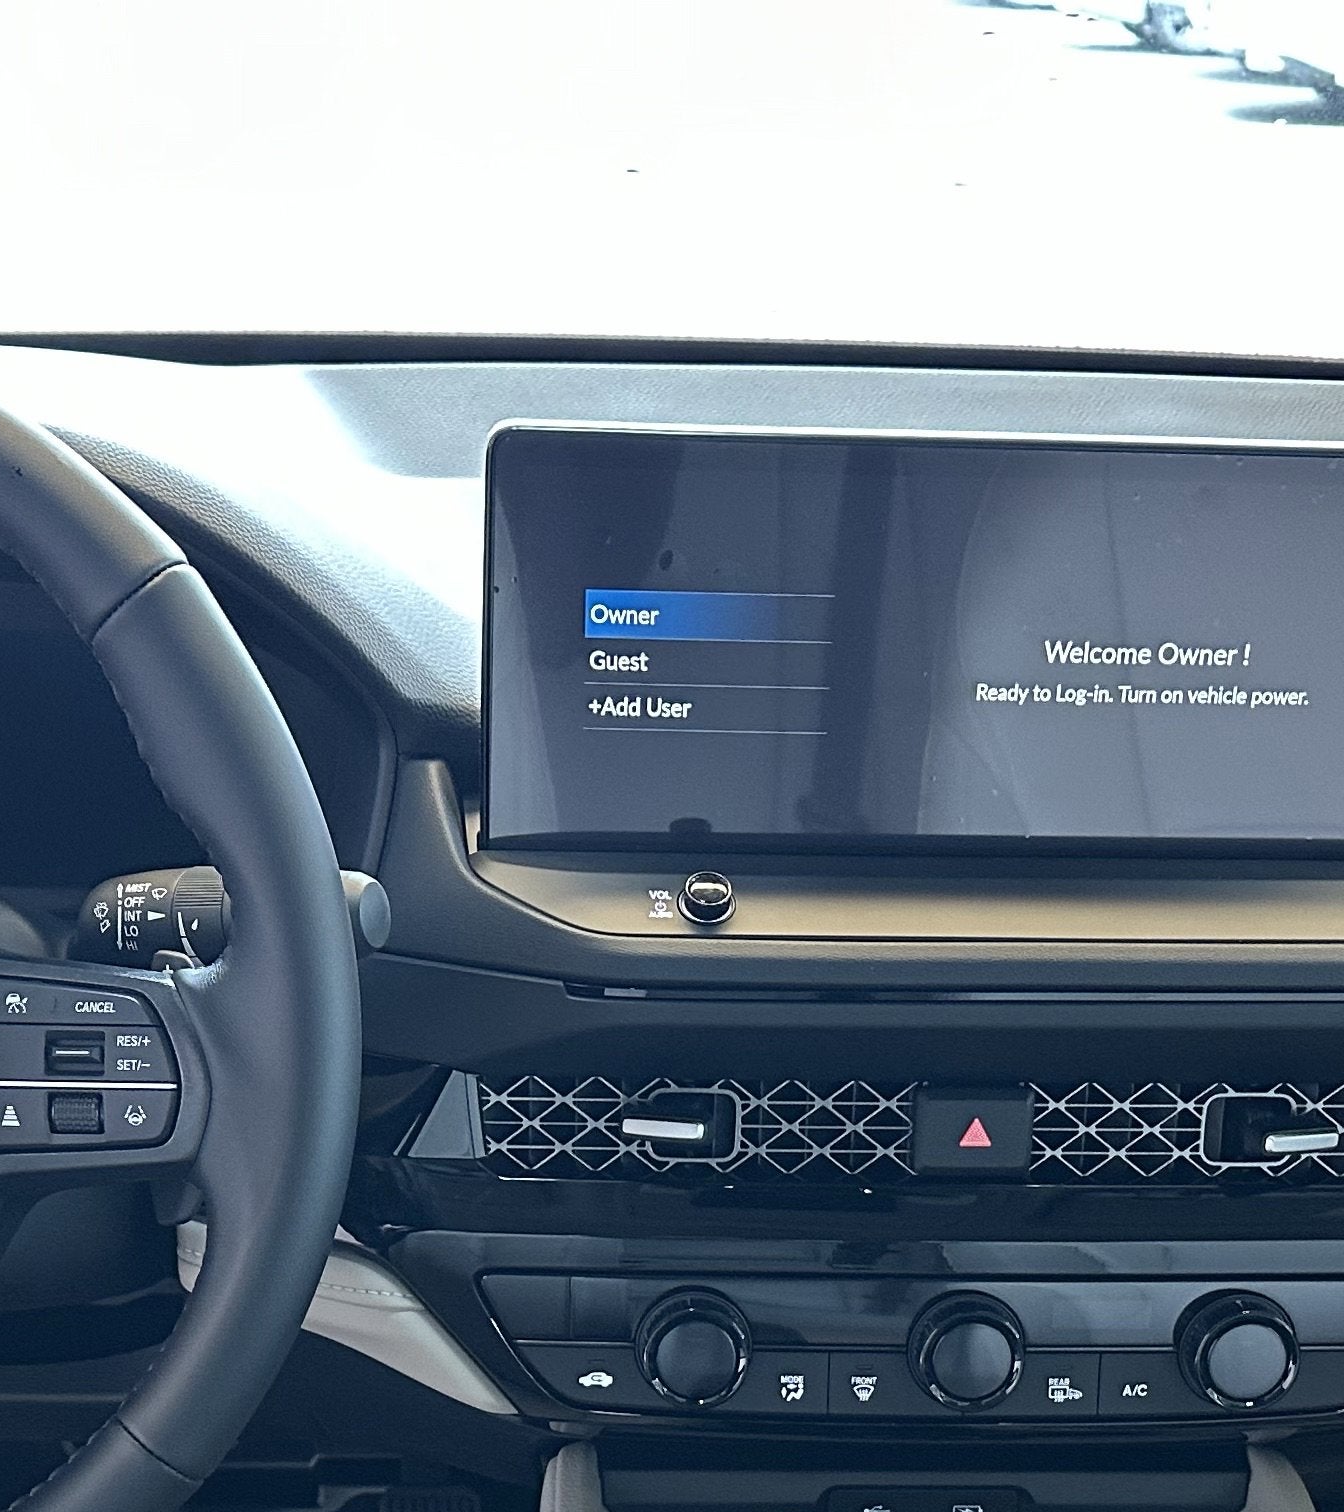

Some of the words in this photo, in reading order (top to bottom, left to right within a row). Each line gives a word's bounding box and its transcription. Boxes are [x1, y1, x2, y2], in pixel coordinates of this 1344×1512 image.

[589, 603, 661, 626] Owner
[1044, 640, 1152, 665] Welcome
[1158, 642, 1239, 667] Owner
[1242, 642, 1251, 667] !
[588, 650, 650, 672] Guest
[975, 682, 1030, 706] Ready
[1032, 684, 1052, 703] to
[1055, 683, 1114, 706] Log-in.
[1117, 685, 1157, 704] Turn
[1160, 689, 1184, 704] on
[1187, 685, 1248, 706] vehicle
[1250, 689, 1310, 709] power.
[587, 696, 642, 718] +Add
[645, 697, 693, 719] User
[124, 882, 153, 893] MIST
[648, 889, 673, 900] VOL
[123, 896, 146, 908] OFF
[123, 910, 143, 922] INT
[123, 925, 139, 937] LO
[74, 1001, 117, 1013] CANCEL
[116, 1035, 152, 1047] RES/+
[780, 1375, 804, 1384] MODE
[851, 1376, 878, 1385] FRONT
[1048, 1377, 1070, 1386] REAR
[1122, 1383, 1148, 1397] A/C
